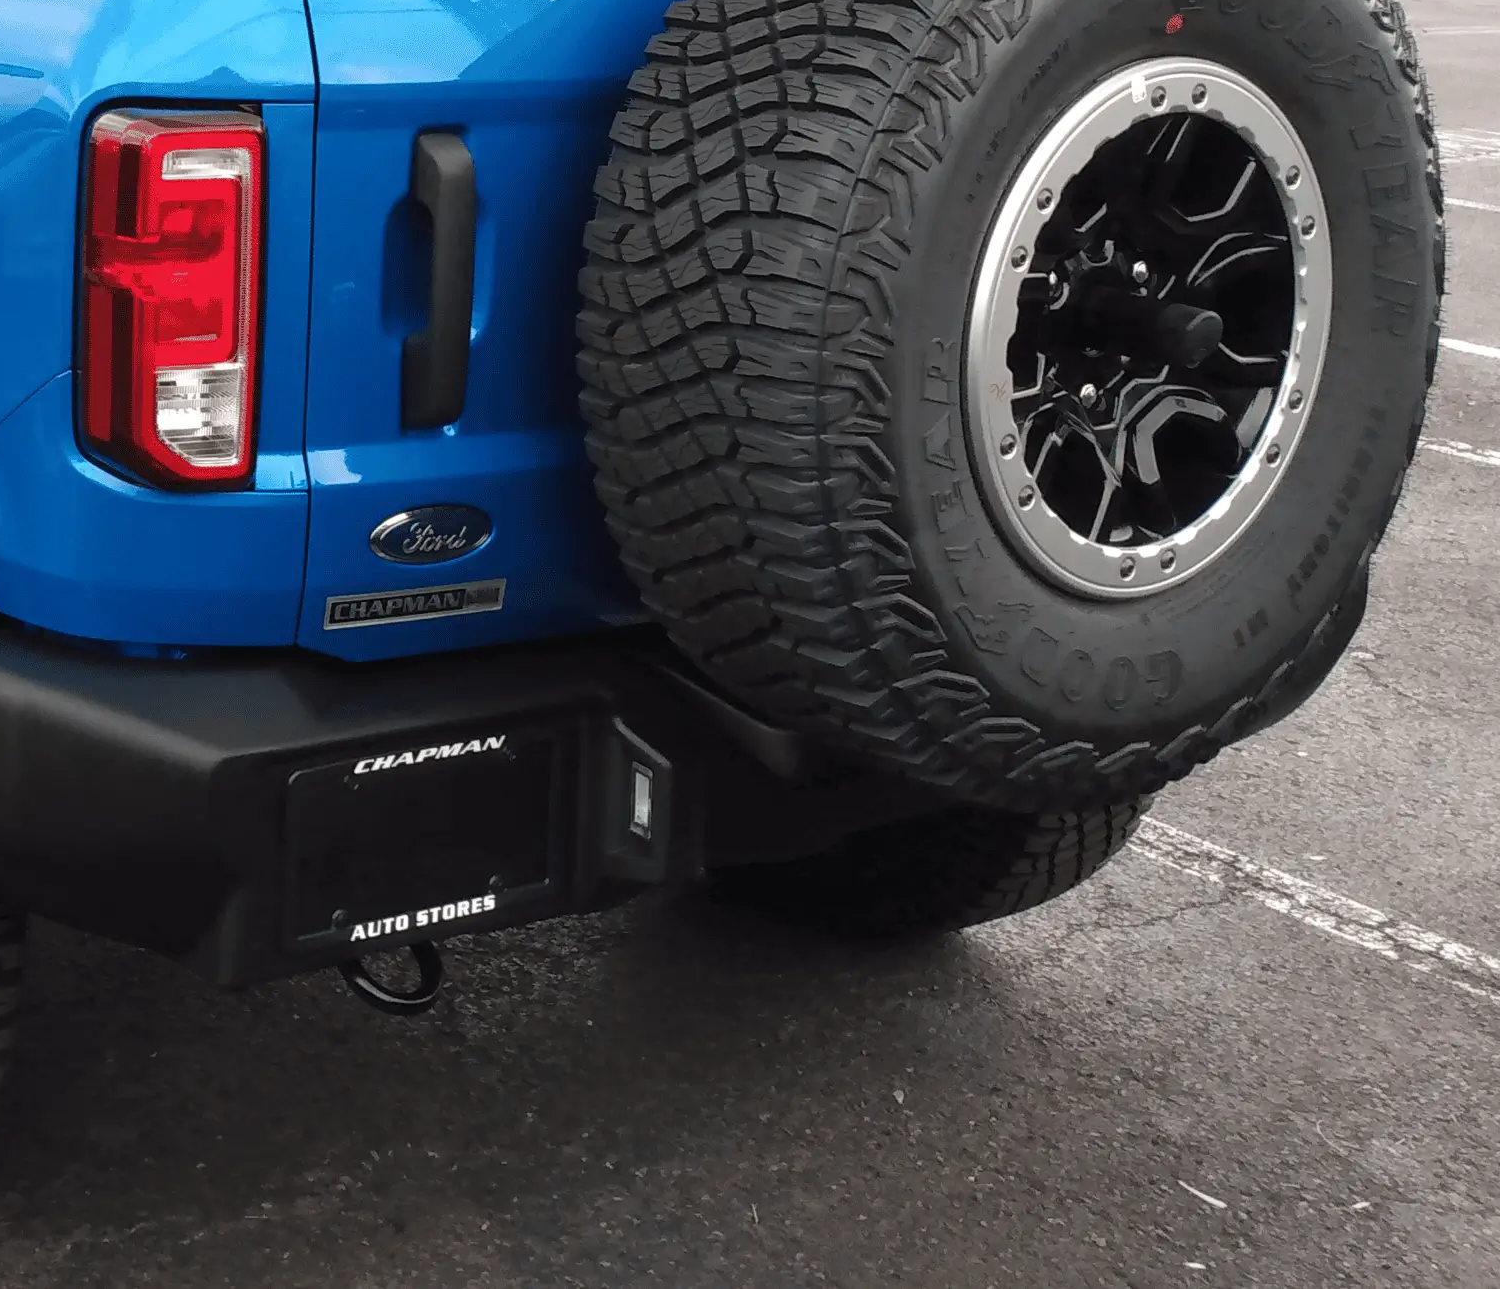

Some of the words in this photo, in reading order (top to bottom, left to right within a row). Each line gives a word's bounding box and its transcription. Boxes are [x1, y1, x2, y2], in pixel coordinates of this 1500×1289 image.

[402, 521, 467, 554] Ford
[333, 591, 462, 621] CHAPMAN
[353, 735, 506, 775] CHAPMAN
[350, 913, 409, 942] AUTO
[415, 894, 496, 927] STORES
